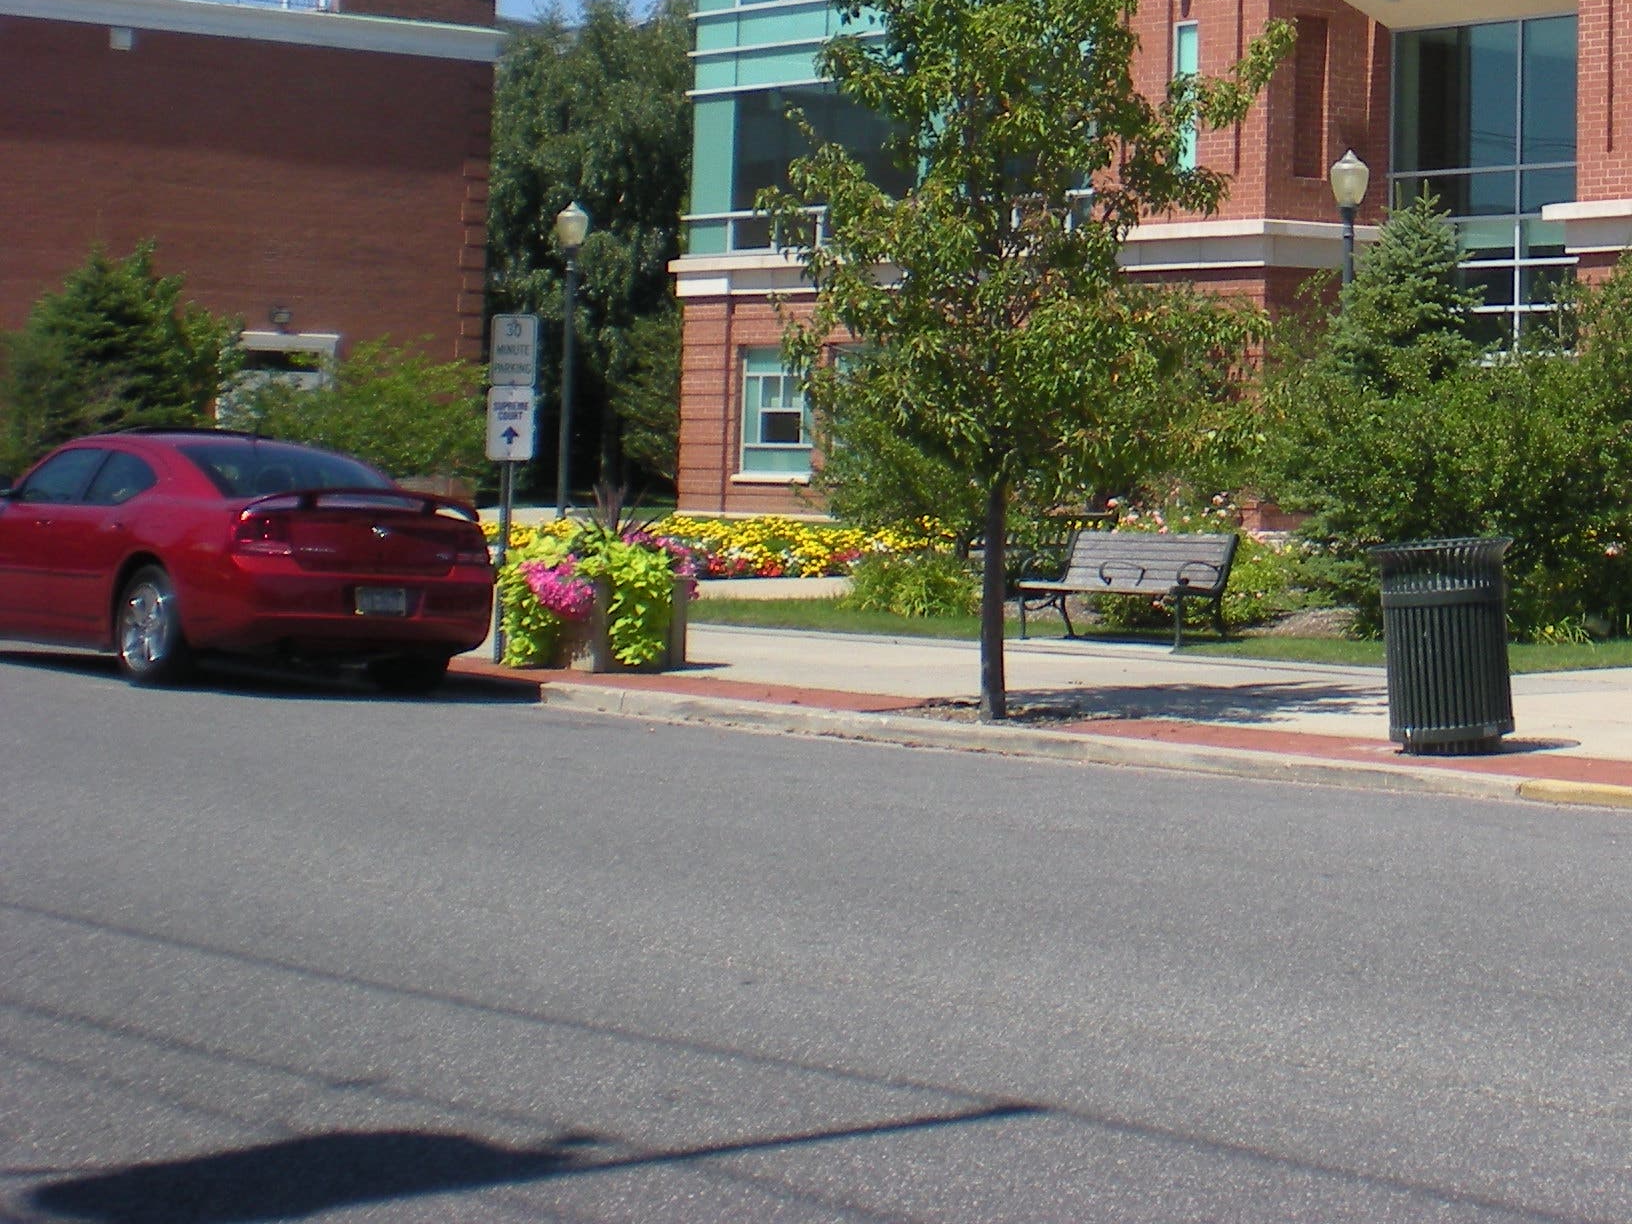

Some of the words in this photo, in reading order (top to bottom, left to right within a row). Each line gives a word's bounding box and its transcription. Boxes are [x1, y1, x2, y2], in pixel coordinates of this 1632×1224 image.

[506, 323, 521, 337] 30
[496, 344, 530, 356] MINUTE
[494, 362, 532, 375] PARKING
[493, 401, 528, 411] SUPREME
[498, 411, 522, 421] COURT
